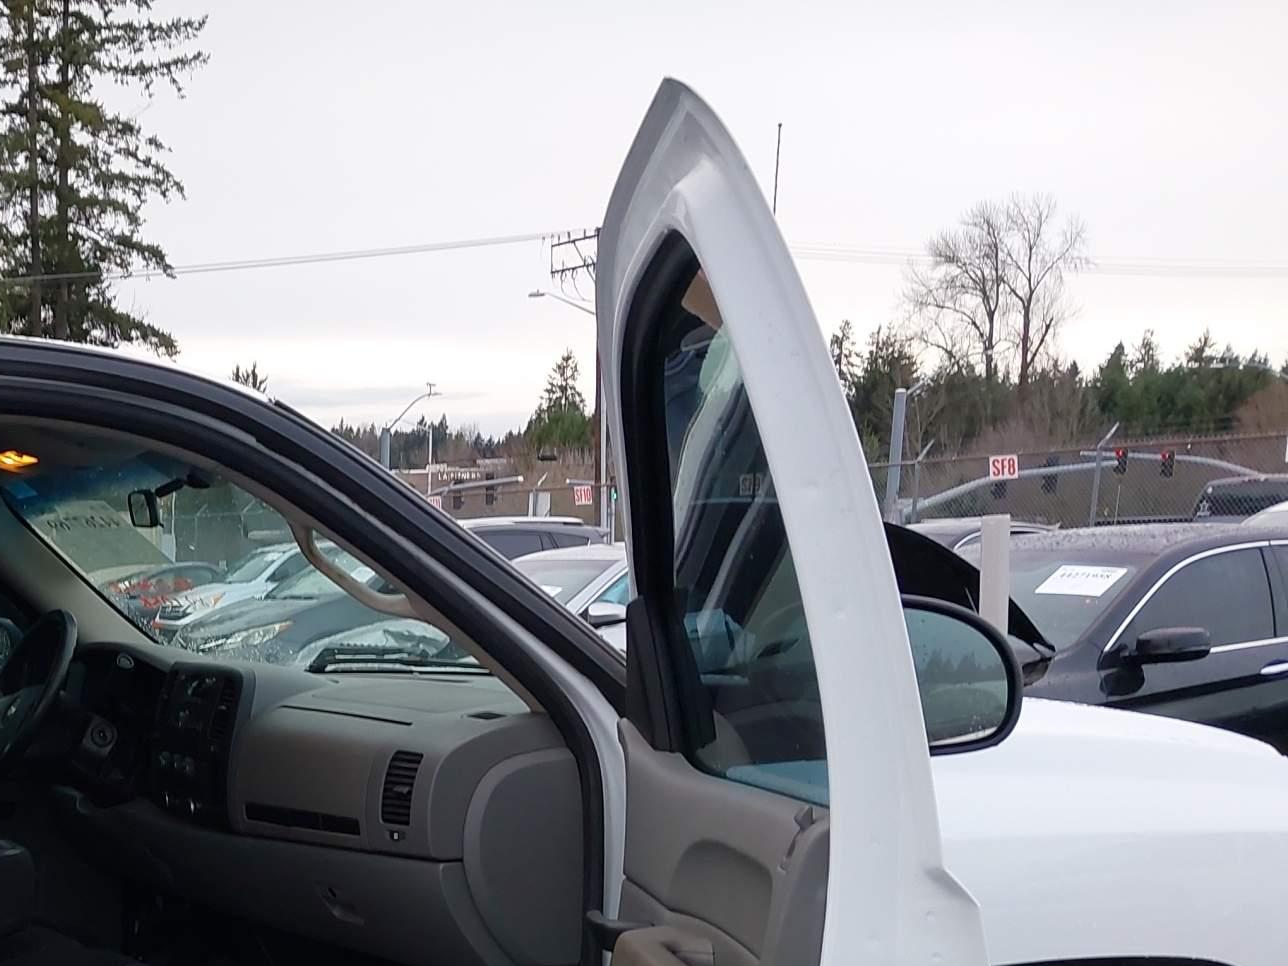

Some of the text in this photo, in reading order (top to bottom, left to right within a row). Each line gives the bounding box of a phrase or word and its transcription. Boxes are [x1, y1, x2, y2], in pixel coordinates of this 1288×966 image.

[992, 457, 1016, 477] SF8
[438, 471, 448, 481] LA
[575, 487, 592, 503] SF10
